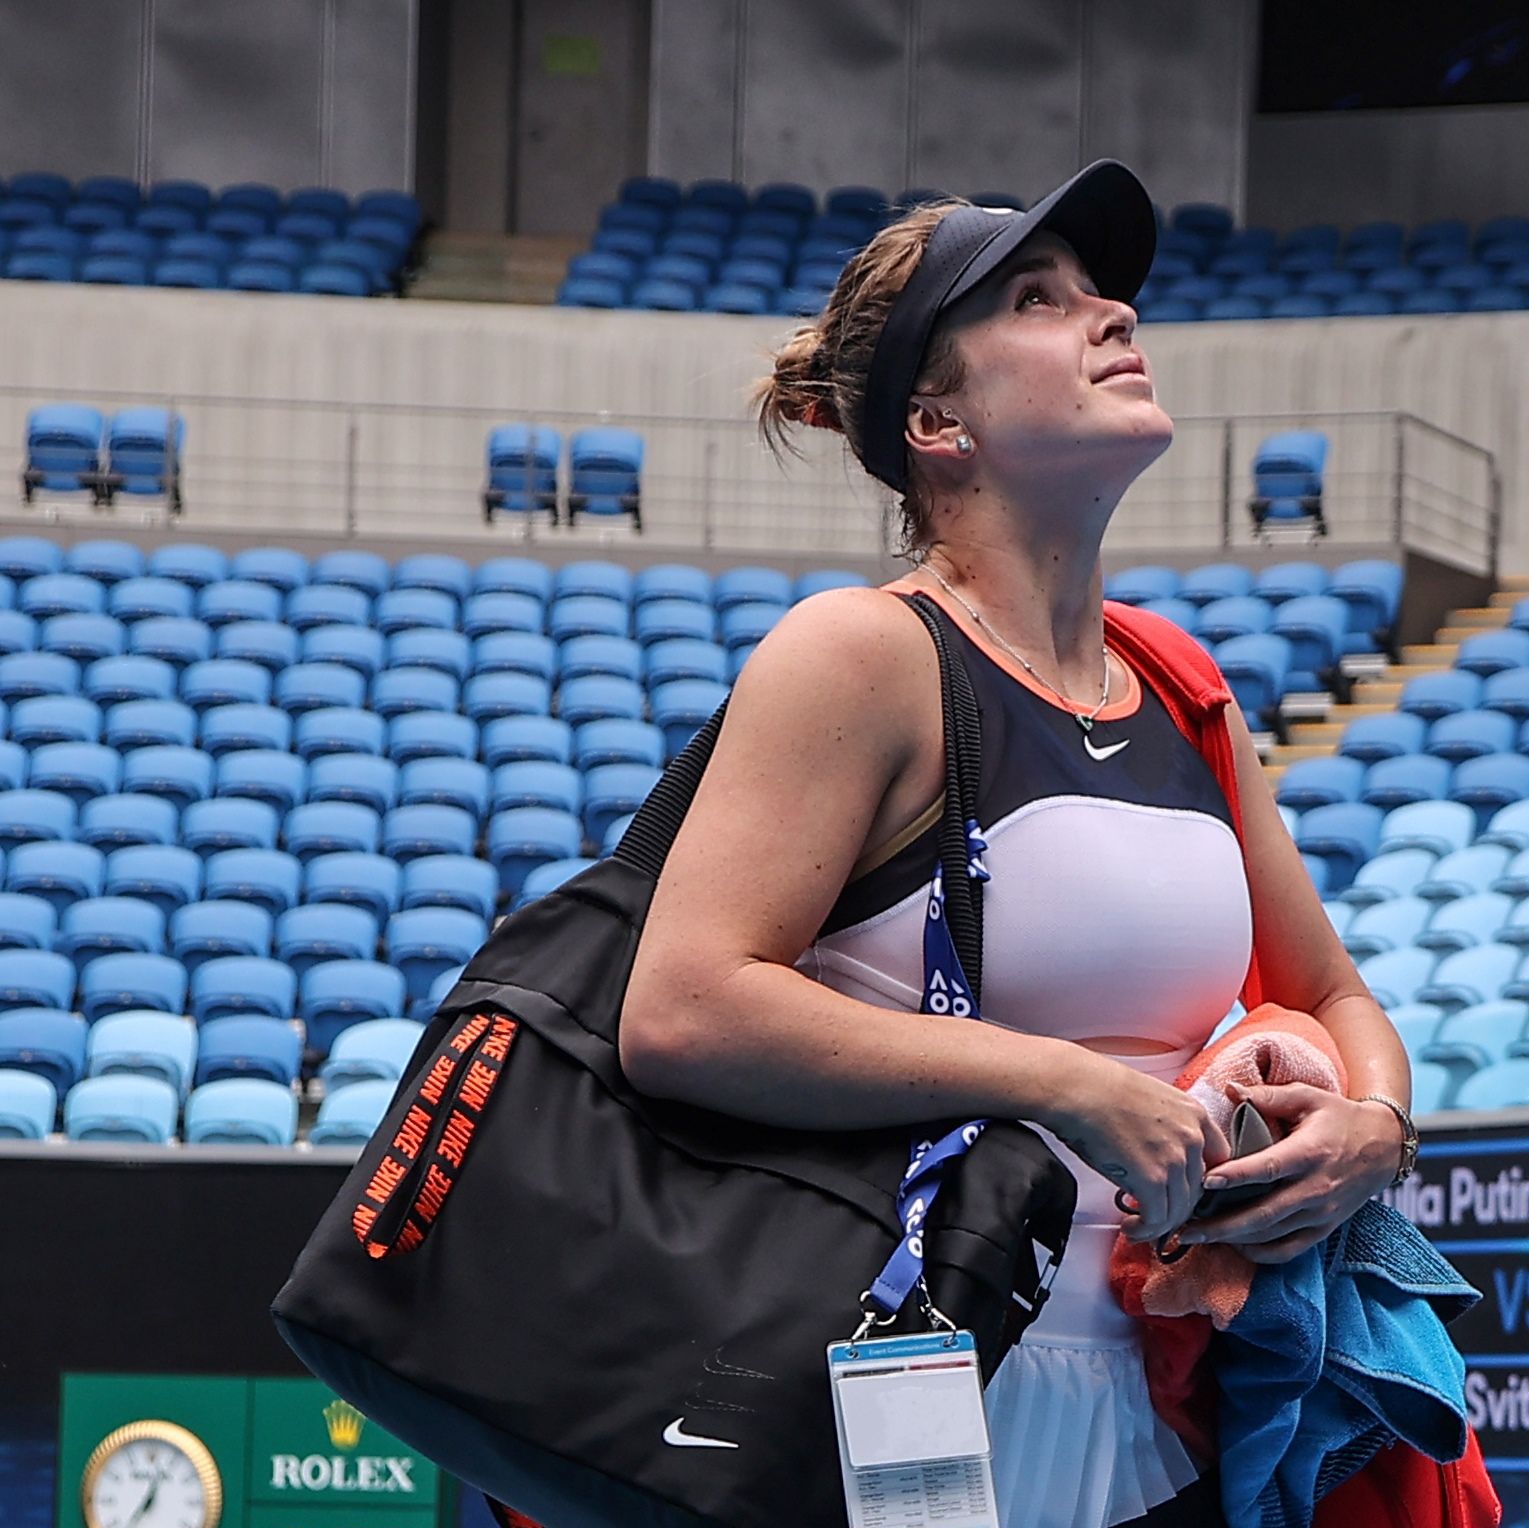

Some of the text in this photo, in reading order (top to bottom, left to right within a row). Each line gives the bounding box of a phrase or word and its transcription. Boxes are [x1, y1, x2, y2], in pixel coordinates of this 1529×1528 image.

[450, 1012, 491, 1054] NIKE
[479, 1015, 518, 1062] NIKE
[418, 1054, 457, 1106] NIKE
[458, 1060, 497, 1112] NIKE
[392, 1103, 433, 1160] NIKE
[435, 1109, 476, 1169] NIKE
[364, 1155, 407, 1204] NIKE
[413, 1163, 453, 1224] NIKE
[1369, 1168, 1446, 1226] ulia
[271, 1453, 414, 1492] ROLEX
